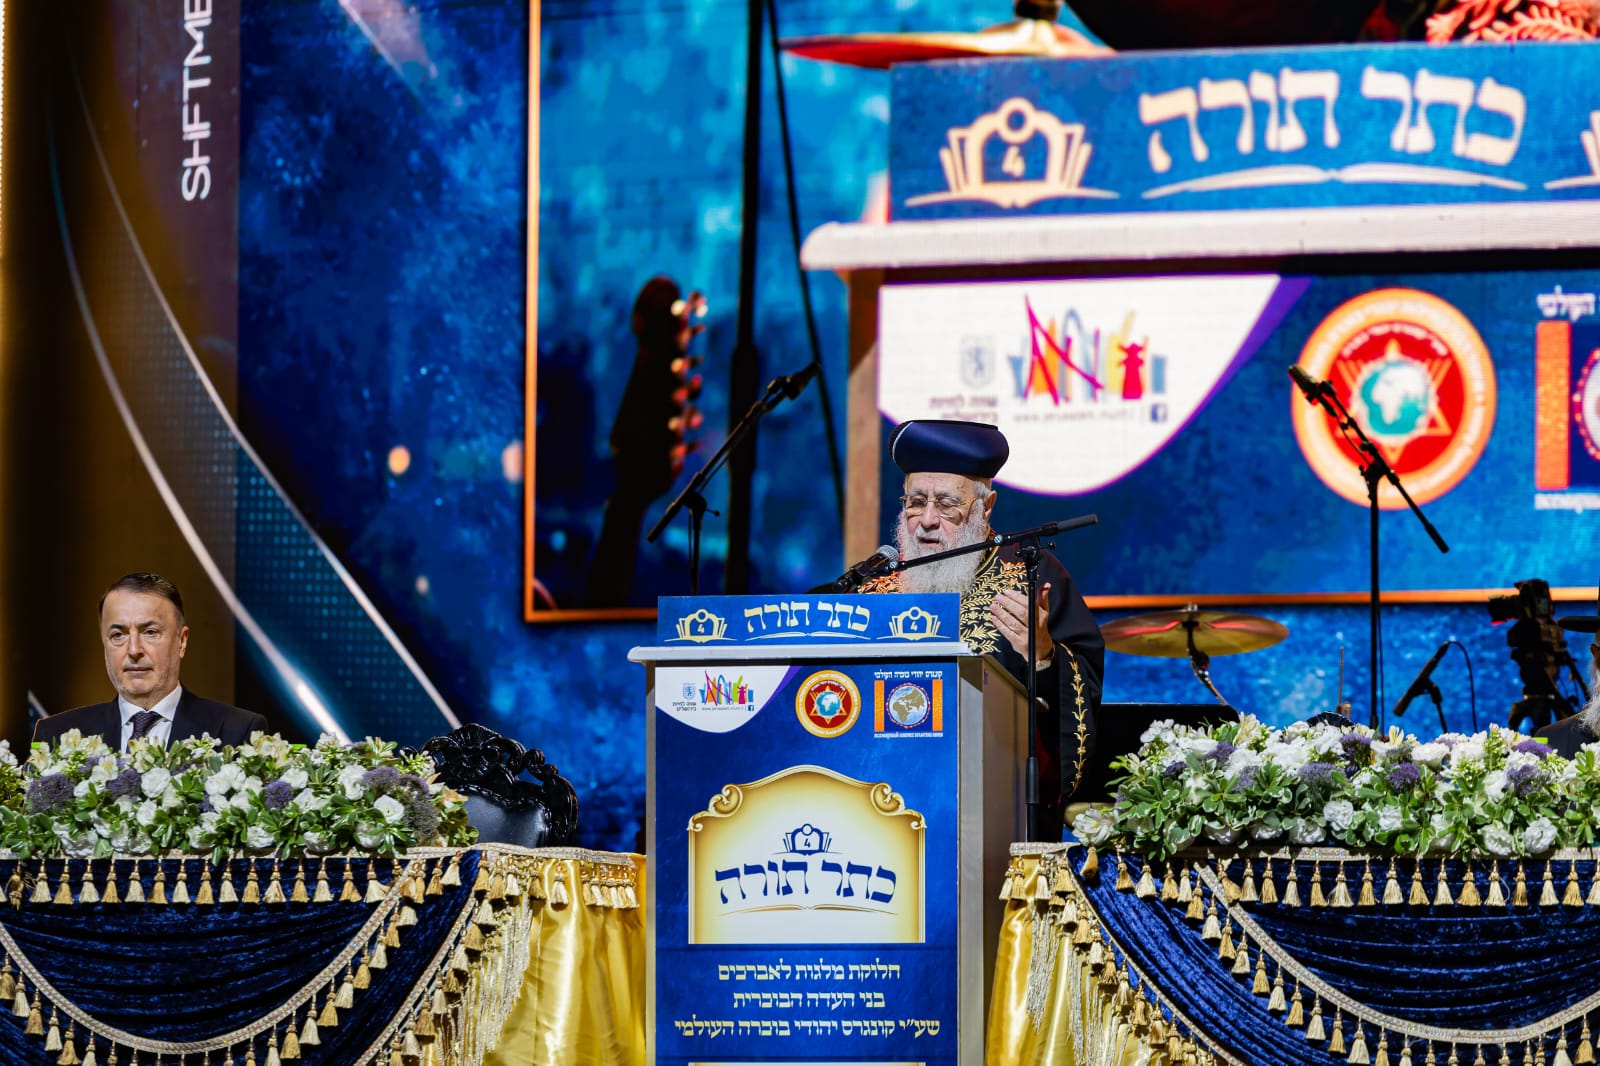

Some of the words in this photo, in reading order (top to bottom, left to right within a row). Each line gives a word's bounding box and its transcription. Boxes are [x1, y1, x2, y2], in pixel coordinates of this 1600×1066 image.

[1138, 67, 1340, 173] תורה
[1361, 65, 1526, 166] כתר
[744, 600, 810, 633] תורה
[817, 600, 871, 632] כתר
[910, 622, 918, 632] 4
[697, 623, 705, 634] 4
[803, 838, 811, 849] 4
[715, 859, 809, 905] תורה
[821, 859, 897, 904] כתר
[718, 958, 792, 981] לאברכים
[795, 958, 845, 981] מלגות
[849, 957, 901, 983] חלוקת
[733, 992, 803, 1009] הבוכרית
[806, 992, 855, 1010] העדה
[859, 991, 886, 1009] בני
[674, 1013, 735, 1039] העולמי
[738, 1019, 791, 1037] בוכרה
[794, 1019, 838, 1036] יהודי
[841, 1019, 896, 1038] קונגרס
